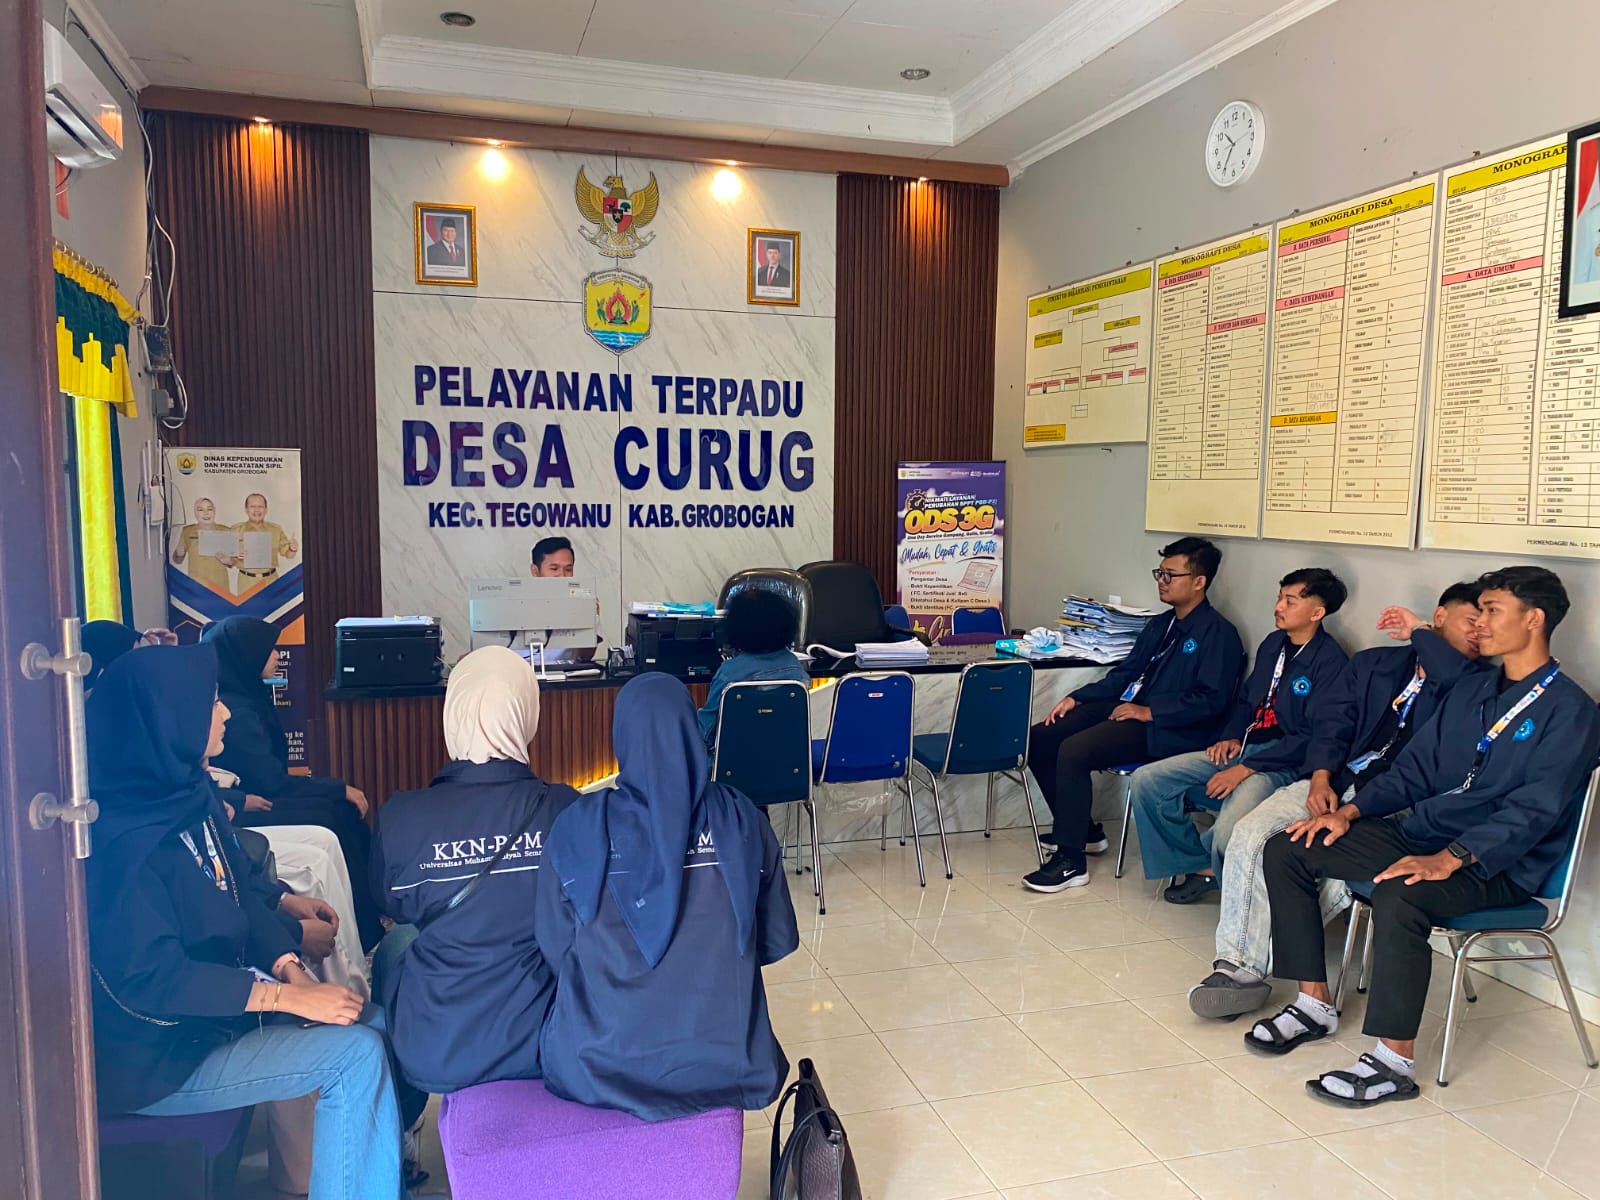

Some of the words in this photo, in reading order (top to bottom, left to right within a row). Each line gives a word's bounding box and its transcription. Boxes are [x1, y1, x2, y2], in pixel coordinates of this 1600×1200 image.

[1232, 112, 1238, 121] 12
[1224, 119, 1229, 129] 11
[1248, 118, 1252, 128] 2
[1217, 132, 1223, 142] 10
[1250, 131, 1254, 141] 3
[1214, 148, 1219, 157] 9
[1246, 147, 1251, 156] 4
[1241, 160, 1245, 169] 5
[1493, 146, 1567, 174] MONOGRAF
[1217, 161, 1221, 170] 8
[1231, 168, 1236, 177] 6
[1309, 208, 1365, 228] MONOGRAFI
[1367, 198, 1393, 210] DESA
[1181, 249, 1222, 265] MONOGRAFI
[1475, 268, 1492, 277] DATA
[1494, 264, 1516, 274] UMUM
[414, 365, 633, 412] PELAYANAN
[652, 375, 804, 418] TERPADU
[402, 420, 575, 488] DESA
[613, 425, 815, 492] CURUG
[904, 508, 959, 534] ODS
[958, 505, 995, 531] 3G
[1526, 539, 1569, 547] PERMENDAGRI
[960, 541, 969, 556] &
[418, 860, 462, 870] Universitas
